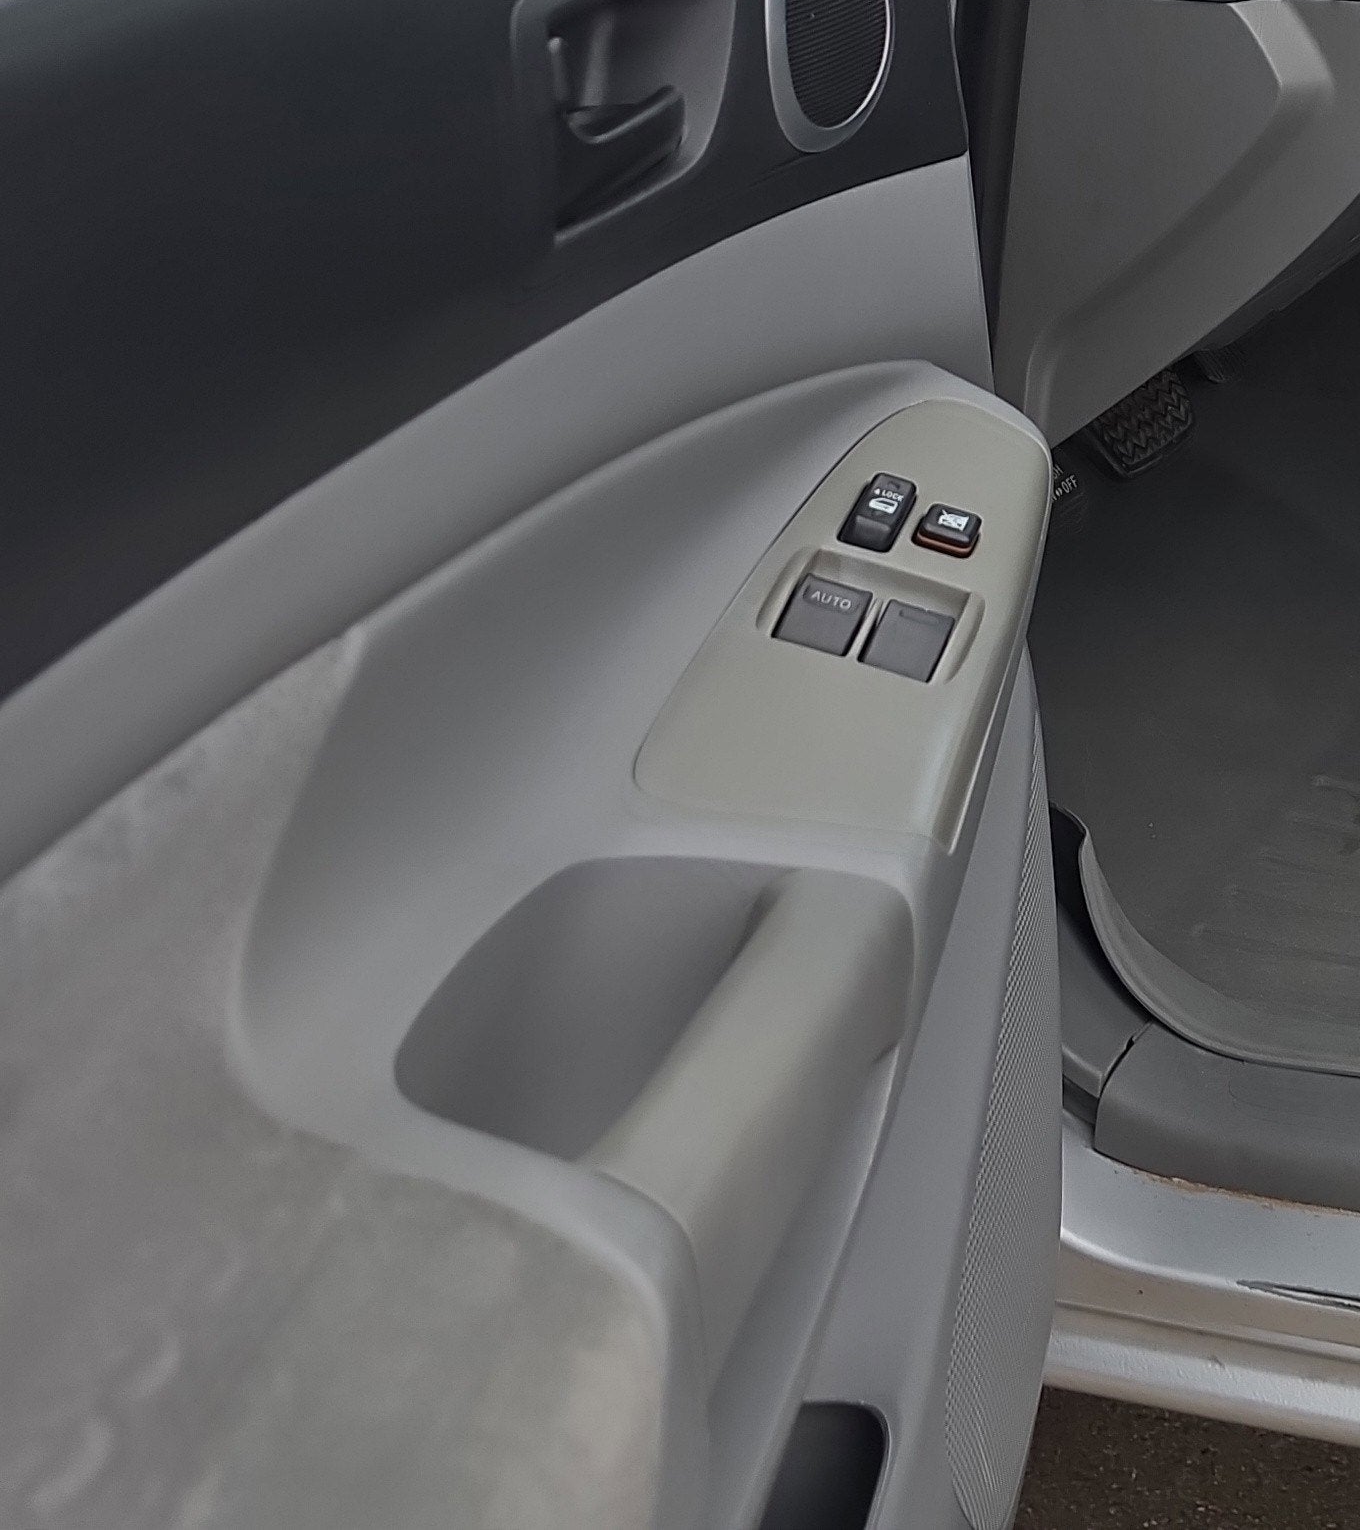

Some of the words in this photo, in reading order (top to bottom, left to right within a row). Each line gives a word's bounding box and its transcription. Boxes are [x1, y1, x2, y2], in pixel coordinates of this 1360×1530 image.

[1061, 474, 1077, 494] OFF
[881, 489, 904, 502] LOCK
[811, 590, 852, 610] AUTO
